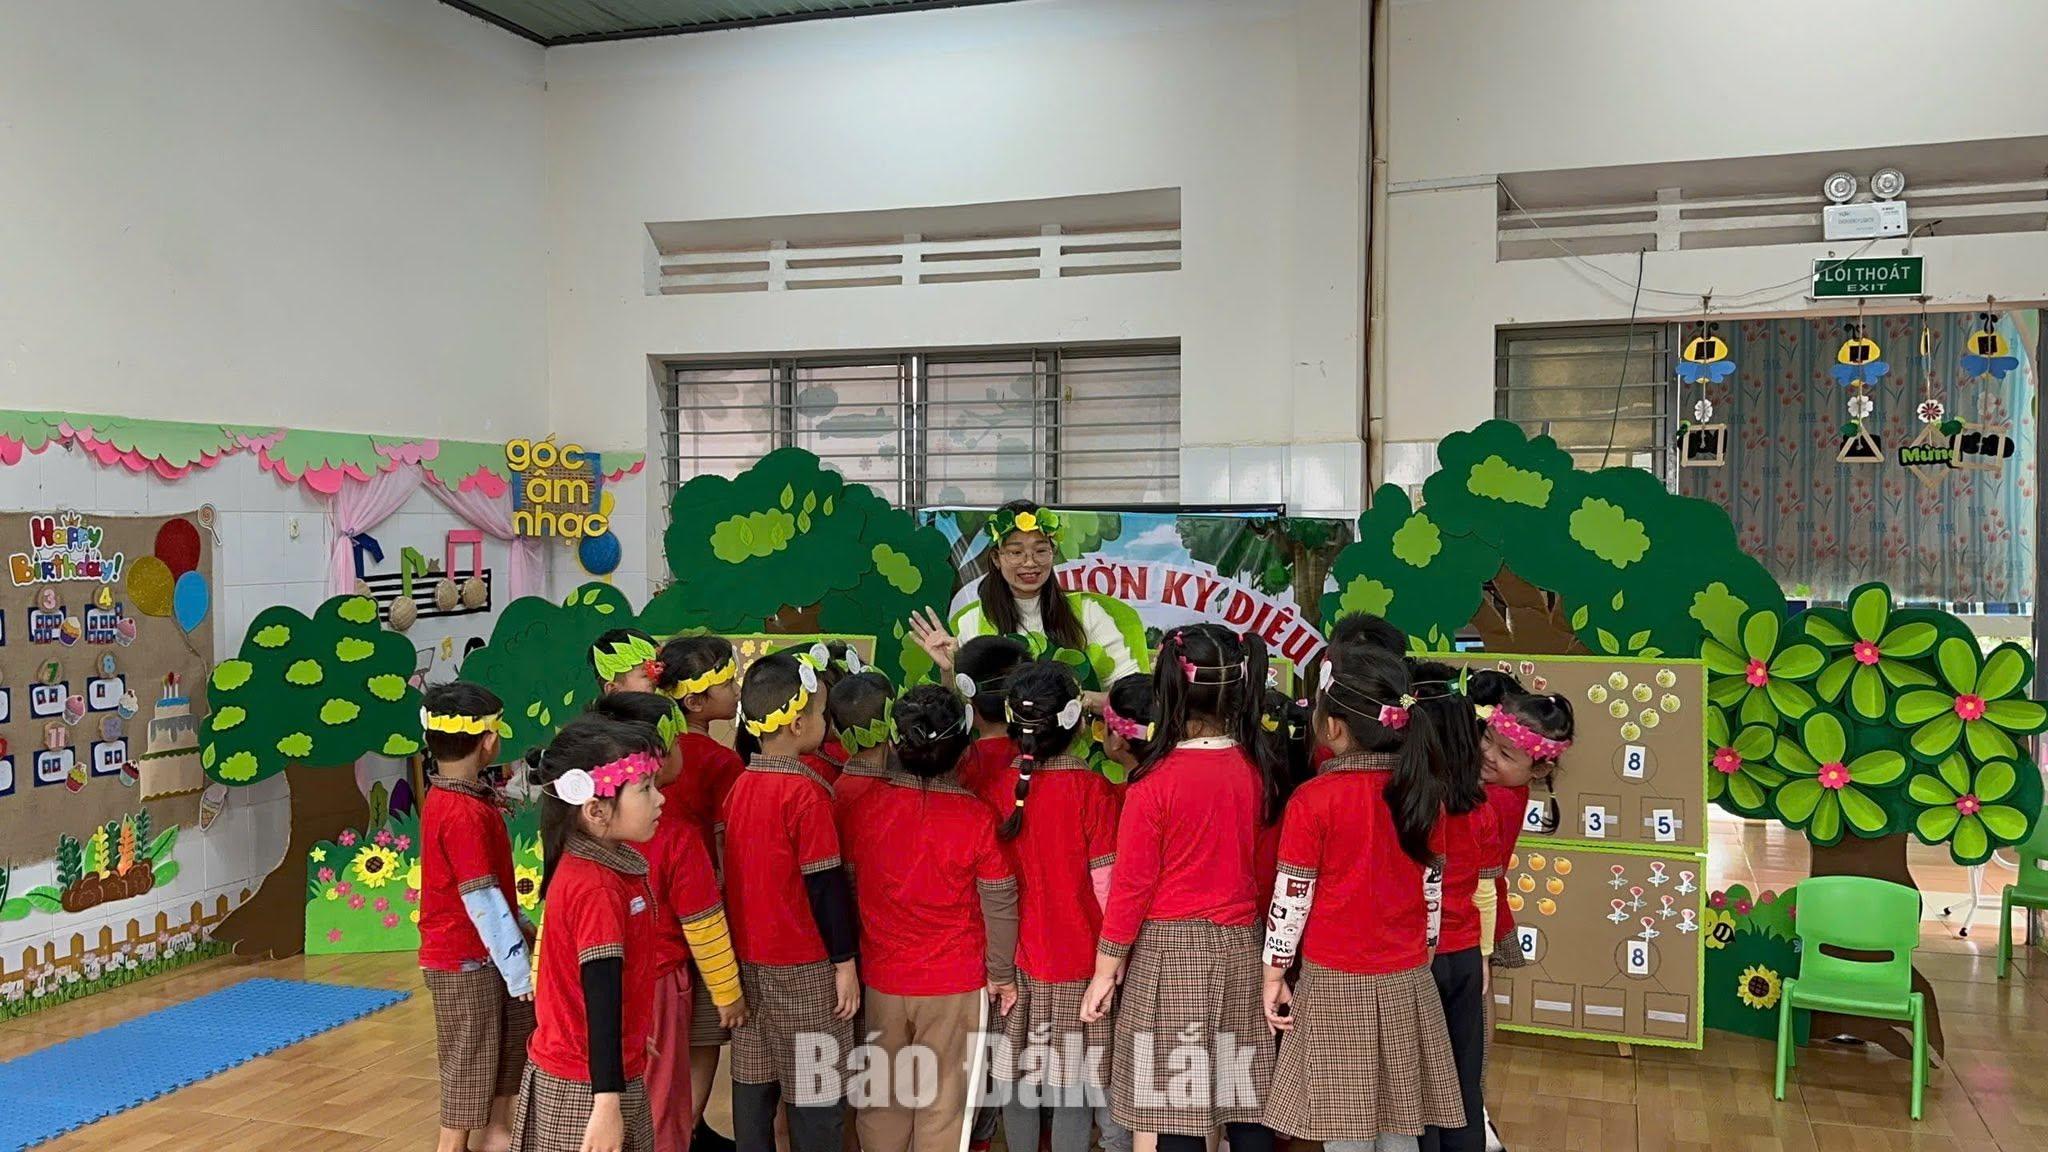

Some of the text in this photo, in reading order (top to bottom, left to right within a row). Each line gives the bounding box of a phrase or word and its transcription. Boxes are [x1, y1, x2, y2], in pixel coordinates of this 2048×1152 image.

[1855, 263, 1910, 280] THOÁT
[1847, 283, 1887, 292] EXIT
[506, 432, 585, 472] góc
[526, 469, 589, 503] âm
[31, 518, 102, 549] Happy
[512, 505, 609, 545] nhạc
[43, 586, 113, 609] 3 4
[1160, 569, 1220, 613] KỲ
[103, 655, 116, 674] 8
[48, 727, 65, 748] 11
[1628, 752, 1640, 770] 8
[1527, 807, 1540, 825] 6
[1589, 813, 1601, 831] 3
[1658, 816, 1671, 834] 5
[1520, 934, 1645, 966] 8 8
